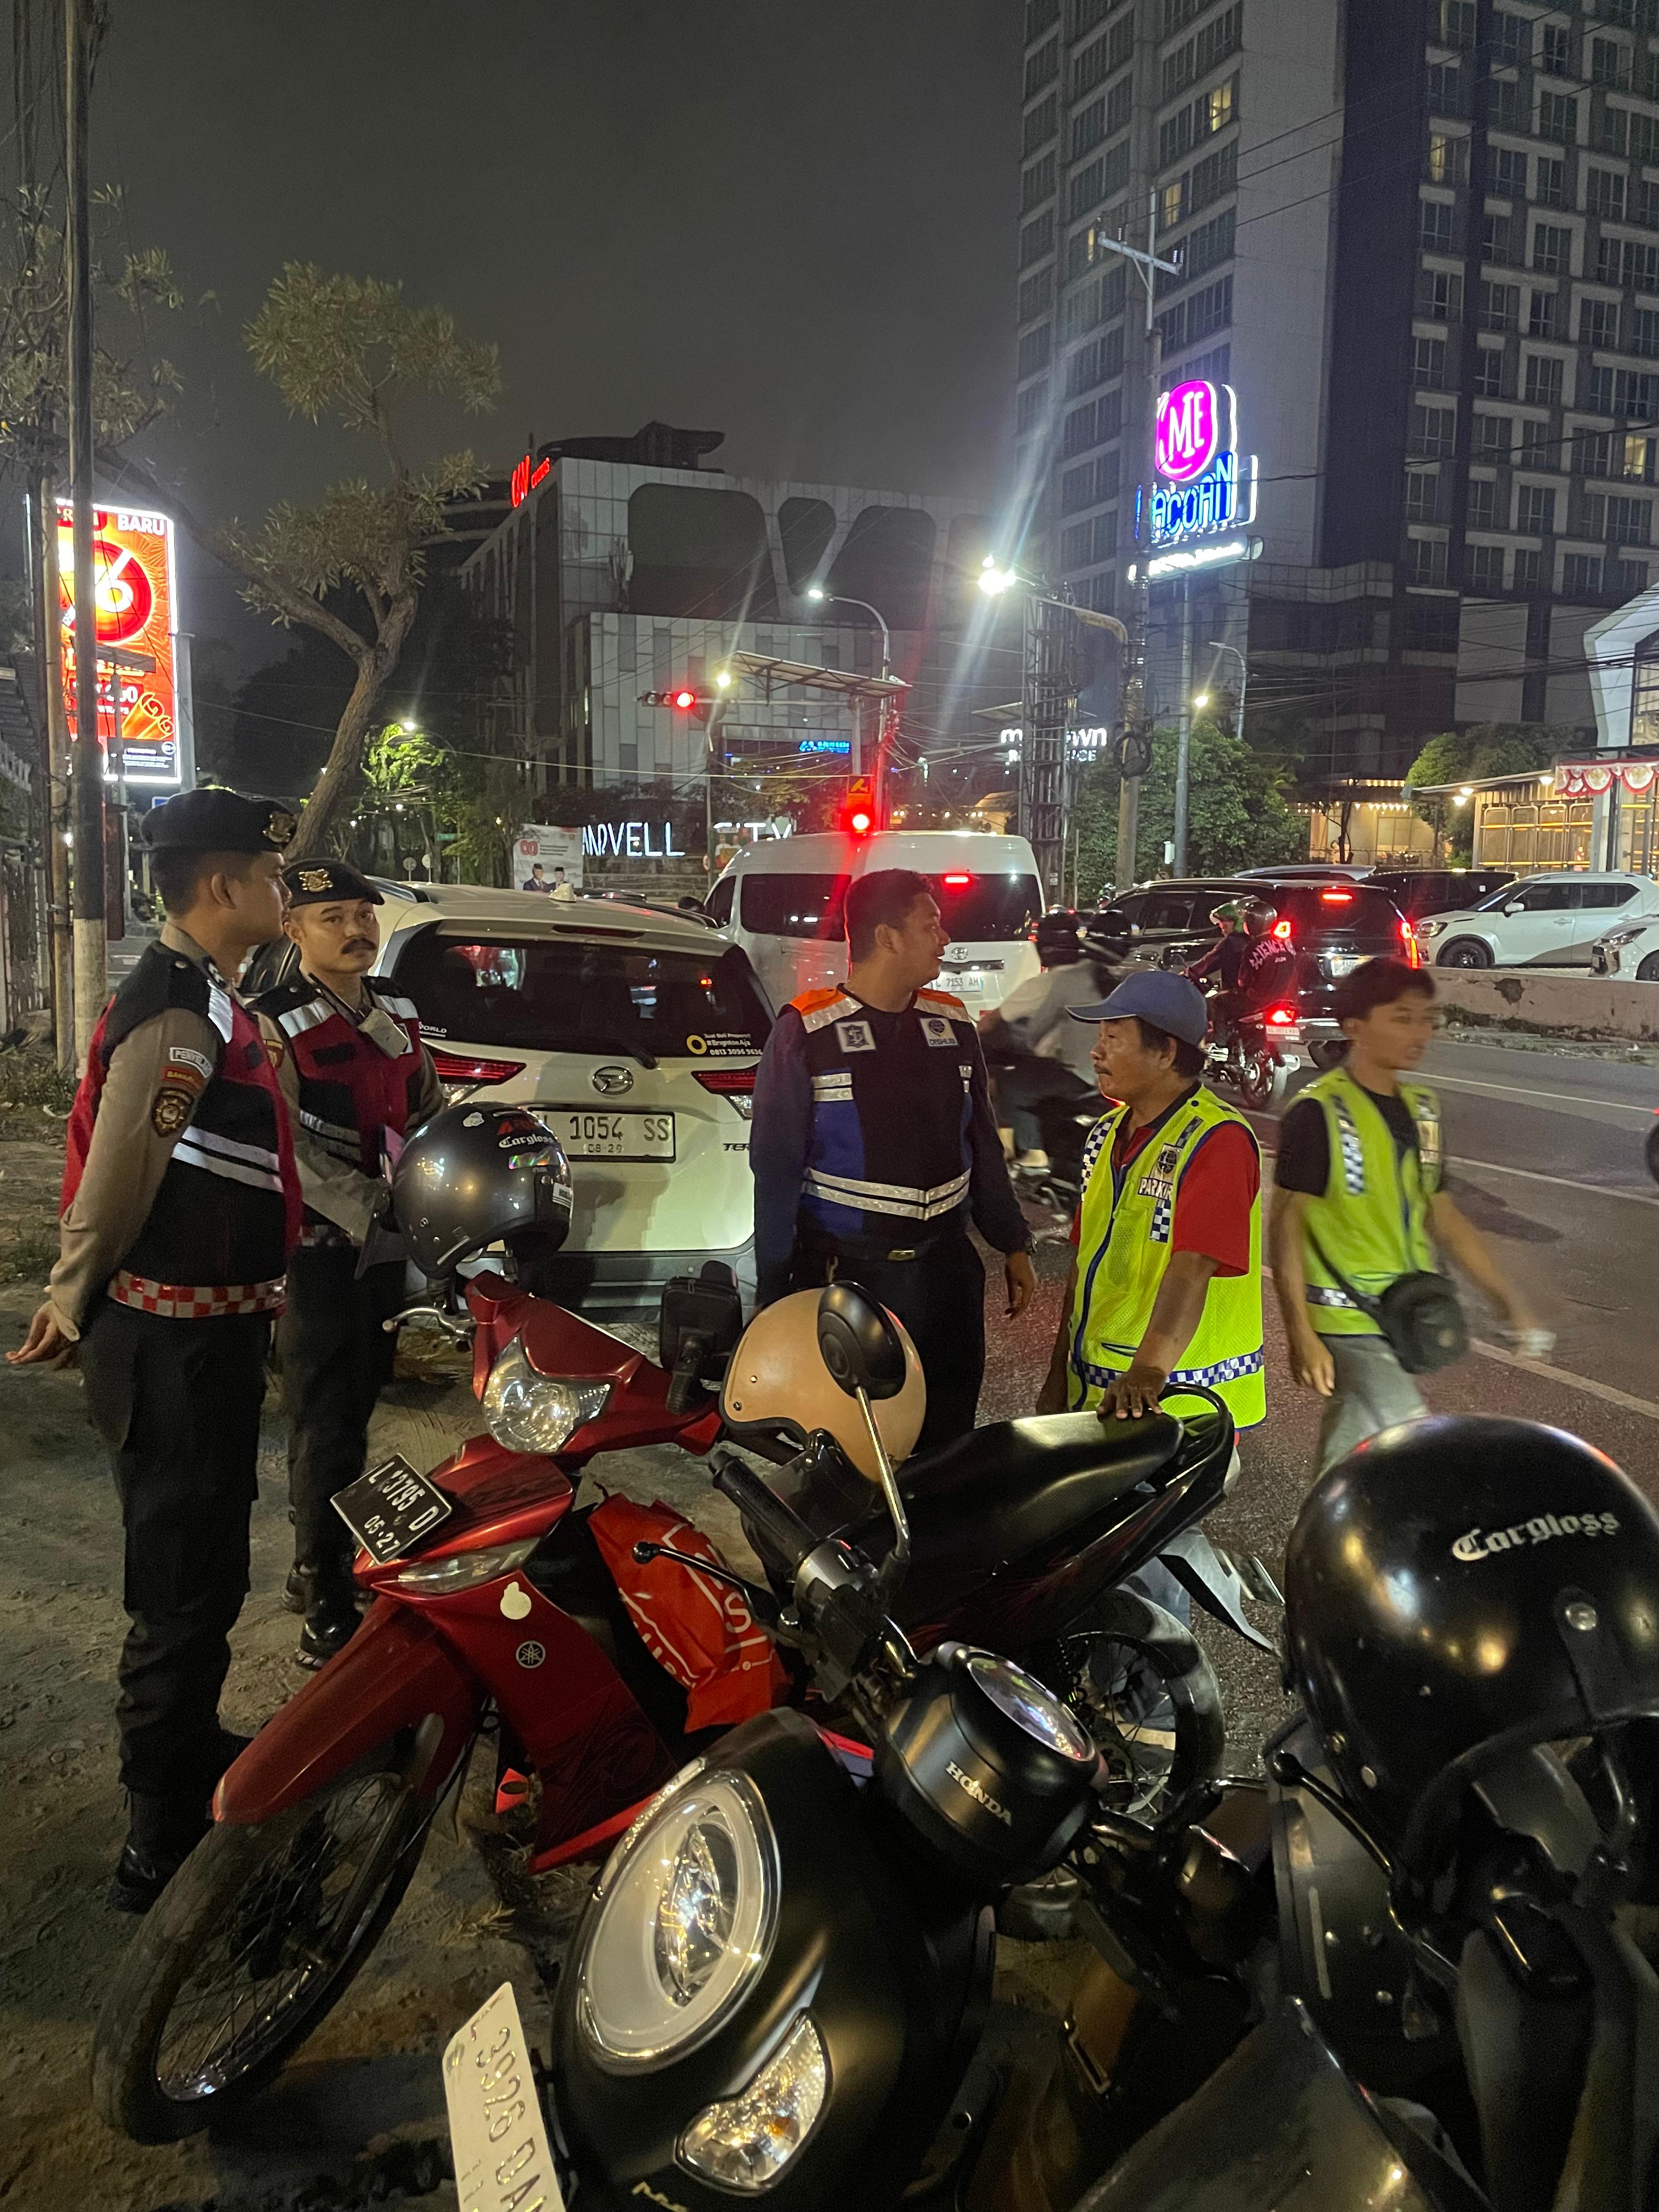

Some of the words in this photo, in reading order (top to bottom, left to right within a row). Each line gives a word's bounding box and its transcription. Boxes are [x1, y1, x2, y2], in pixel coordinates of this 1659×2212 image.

[117, 514, 165, 536] BARU
[1249, 939, 1286, 970] SCIENCE
[946, 978, 963, 987] 7153
[969, 978, 978, 986] AH
[498, 1134, 554, 1148] Cargloss
[569, 1116, 624, 1140] 1054
[644, 1118, 670, 1141] SS
[1139, 1178, 1173, 1201] PARKIR
[369, 1462, 395, 1483] L
[408, 1505, 439, 1531] D
[1452, 1512, 1621, 1561] Cargloss
[946, 1760, 1012, 1827] HONDA
[476, 2026, 525, 2143] 3926
